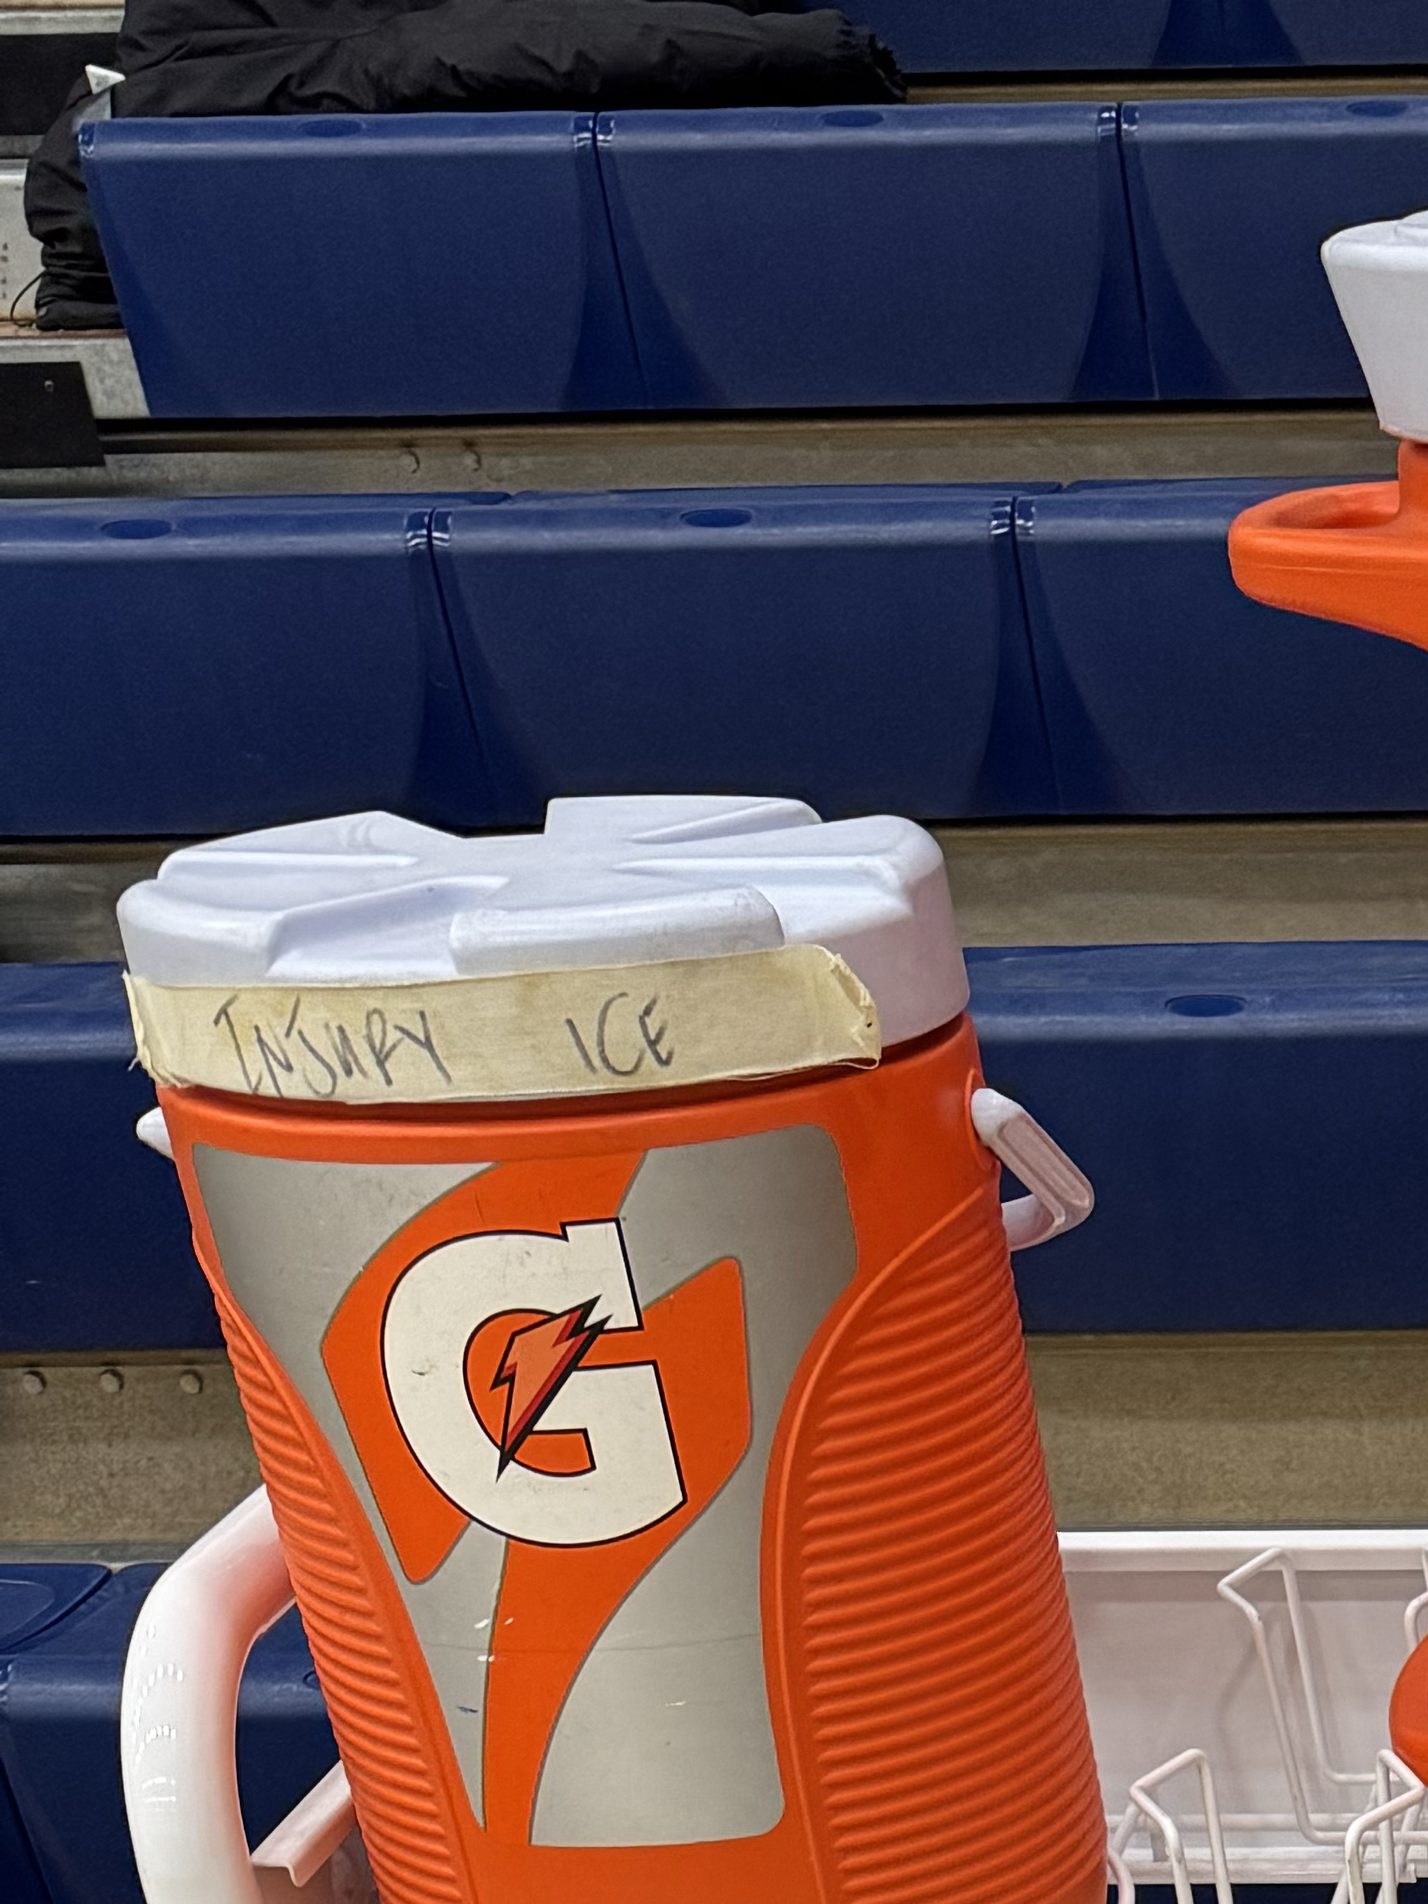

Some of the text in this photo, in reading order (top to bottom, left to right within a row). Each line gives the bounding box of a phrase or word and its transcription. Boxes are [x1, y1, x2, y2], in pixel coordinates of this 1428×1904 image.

[213, 992, 675, 1098] INJURY ICE
[381, 1217, 687, 1548] G
